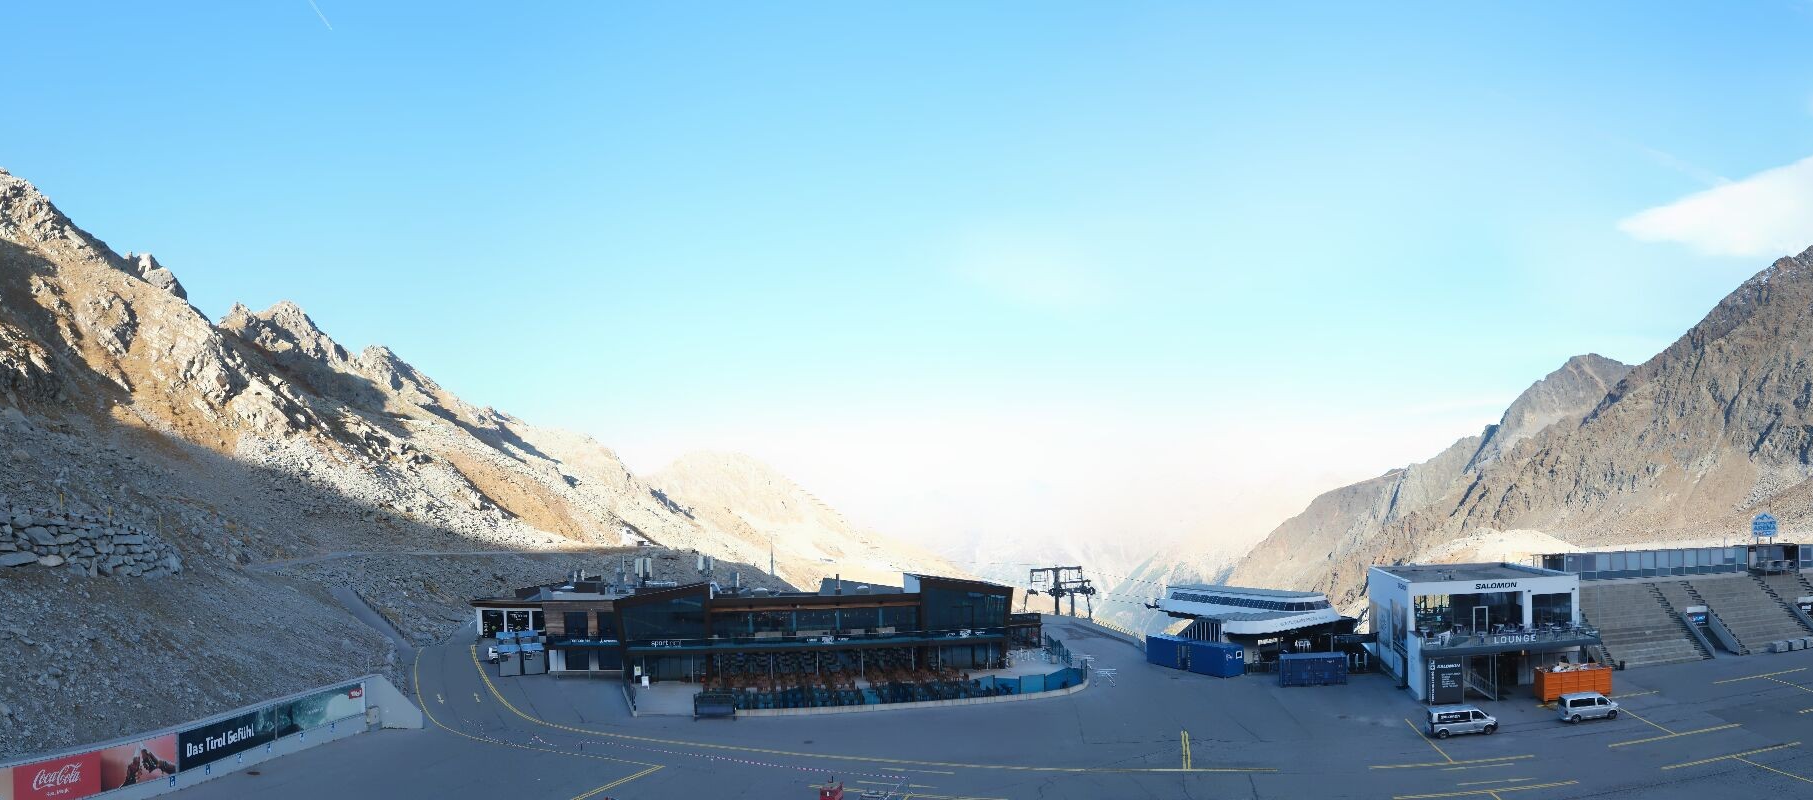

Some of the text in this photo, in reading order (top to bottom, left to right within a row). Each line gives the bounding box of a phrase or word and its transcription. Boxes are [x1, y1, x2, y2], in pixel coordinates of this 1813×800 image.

[1475, 582, 1517, 590] SALOMON
[651, 639, 669, 648] sport
[1494, 634, 1537, 644] LOUNGE
[186, 723, 255, 758] Das Tirol Gefühl
